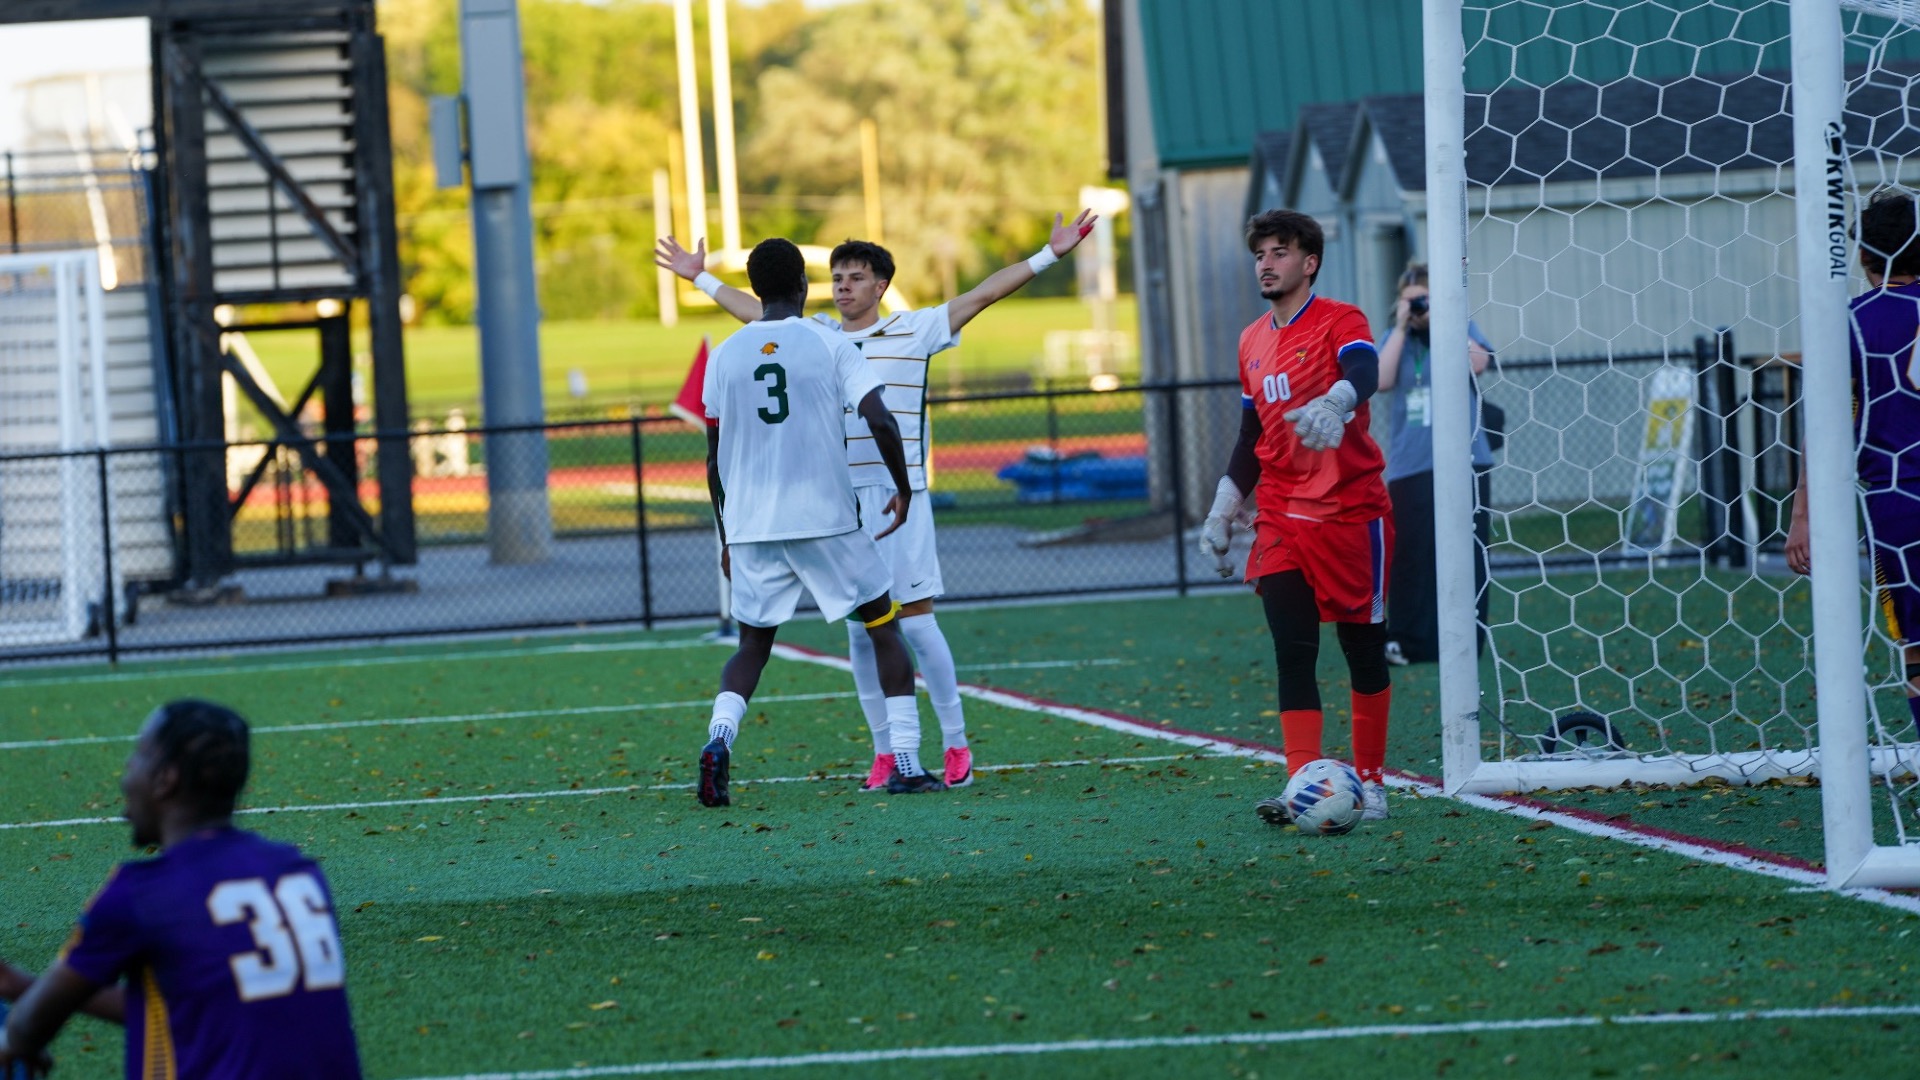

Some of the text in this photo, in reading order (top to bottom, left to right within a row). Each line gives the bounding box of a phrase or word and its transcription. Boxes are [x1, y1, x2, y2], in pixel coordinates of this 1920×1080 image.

[754, 363, 789, 424] 3
[1262, 372, 1291, 404] 00
[206, 873, 345, 1002] 36
